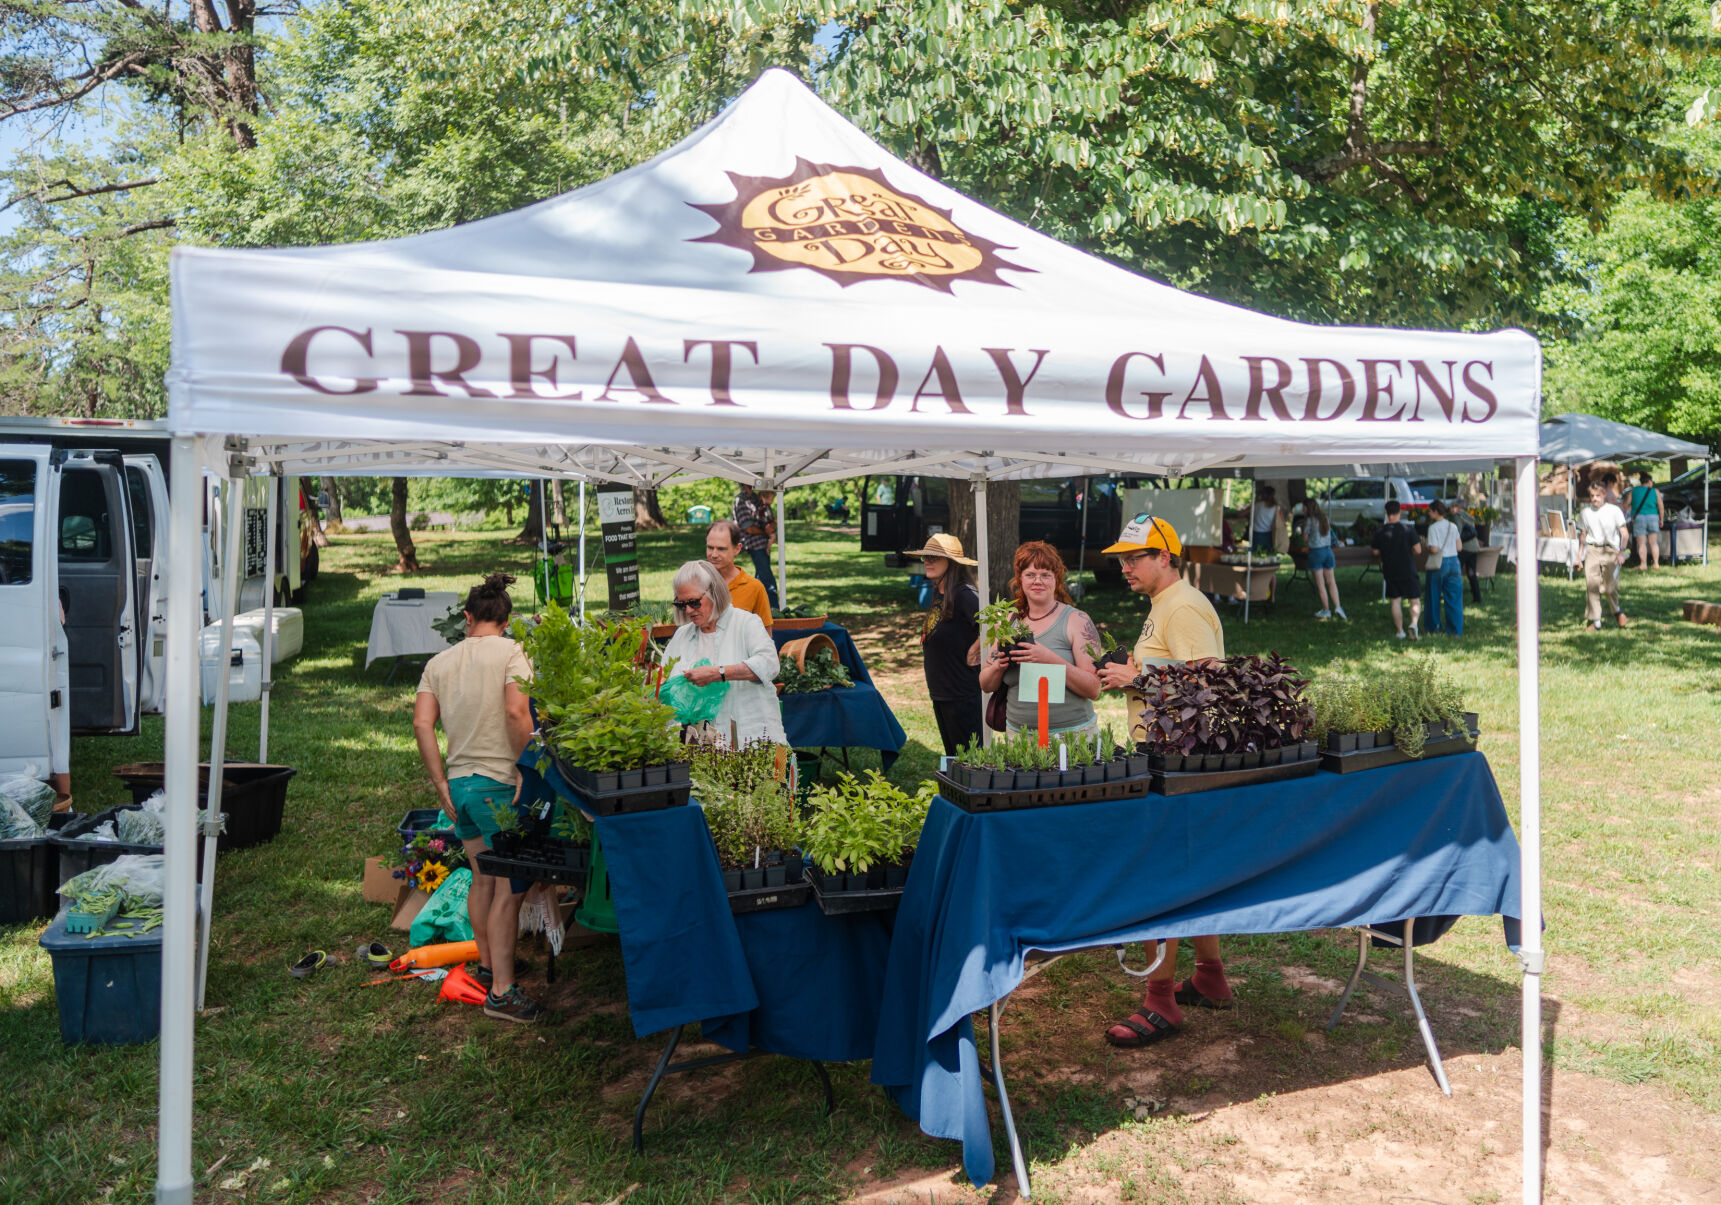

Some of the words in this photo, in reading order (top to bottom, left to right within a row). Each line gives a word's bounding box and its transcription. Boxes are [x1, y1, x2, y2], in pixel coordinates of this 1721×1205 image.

[754, 217, 972, 247] GARDENS
[280, 325, 760, 407] GREAT
[821, 342, 1050, 416] DAY
[1104, 350, 1499, 424] GARDENS
[605, 534, 618, 543] FOOD
